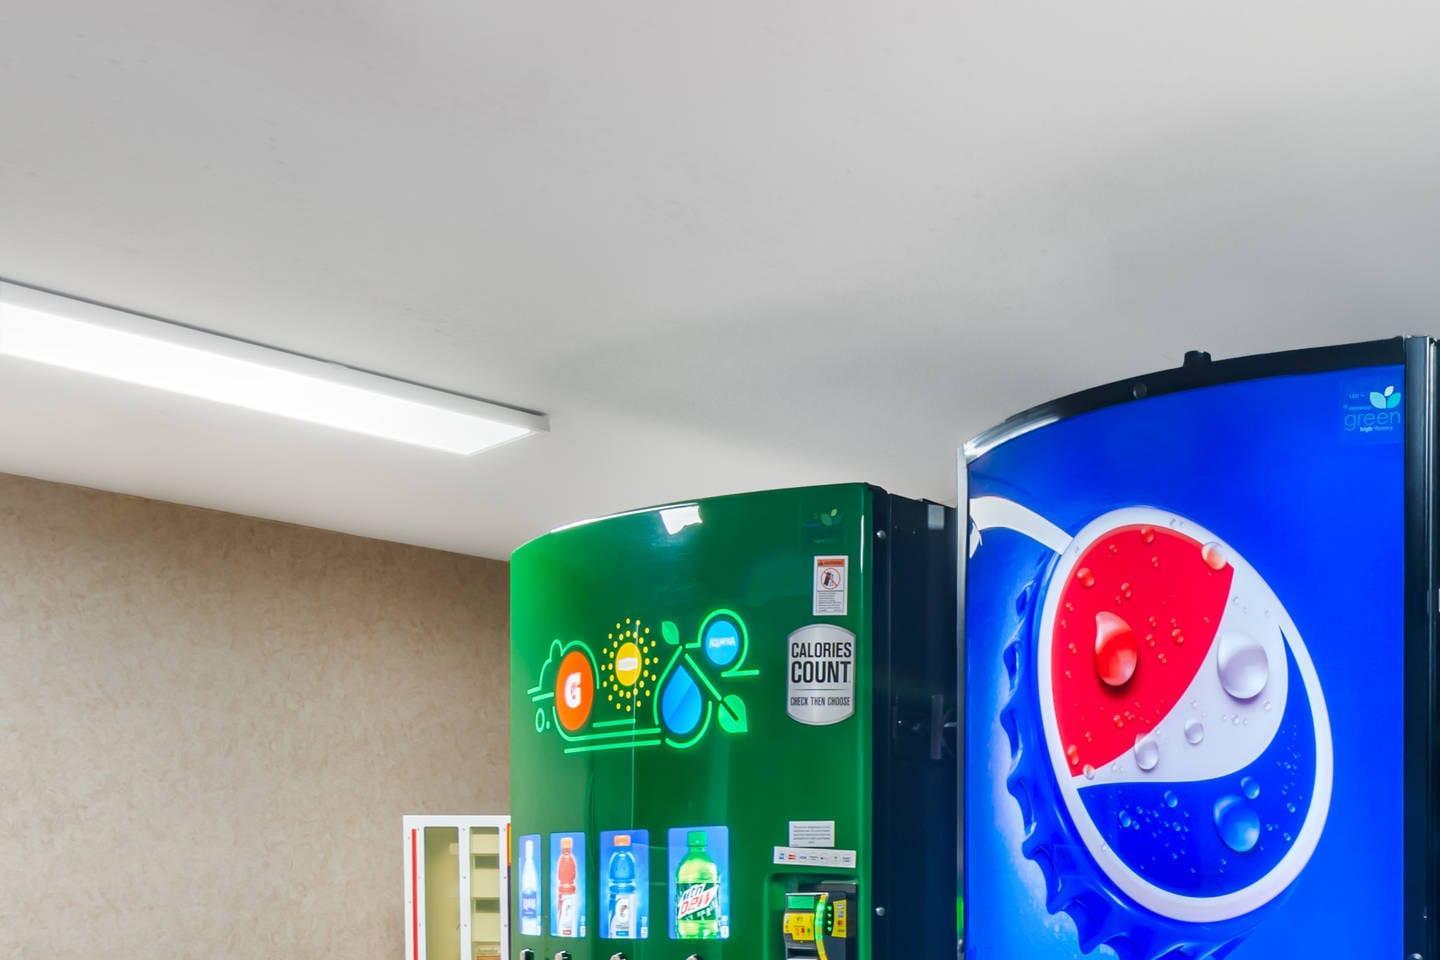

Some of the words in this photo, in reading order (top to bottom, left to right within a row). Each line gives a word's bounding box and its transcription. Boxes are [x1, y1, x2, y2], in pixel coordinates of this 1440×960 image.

[1344, 411, 1401, 432] green
[791, 642, 852, 658] CALORIES
[791, 660, 850, 684] COUNT
[790, 696, 809, 706] CHECK
[811, 696, 826, 706] THEN
[828, 696, 851, 706] CHOOSE
